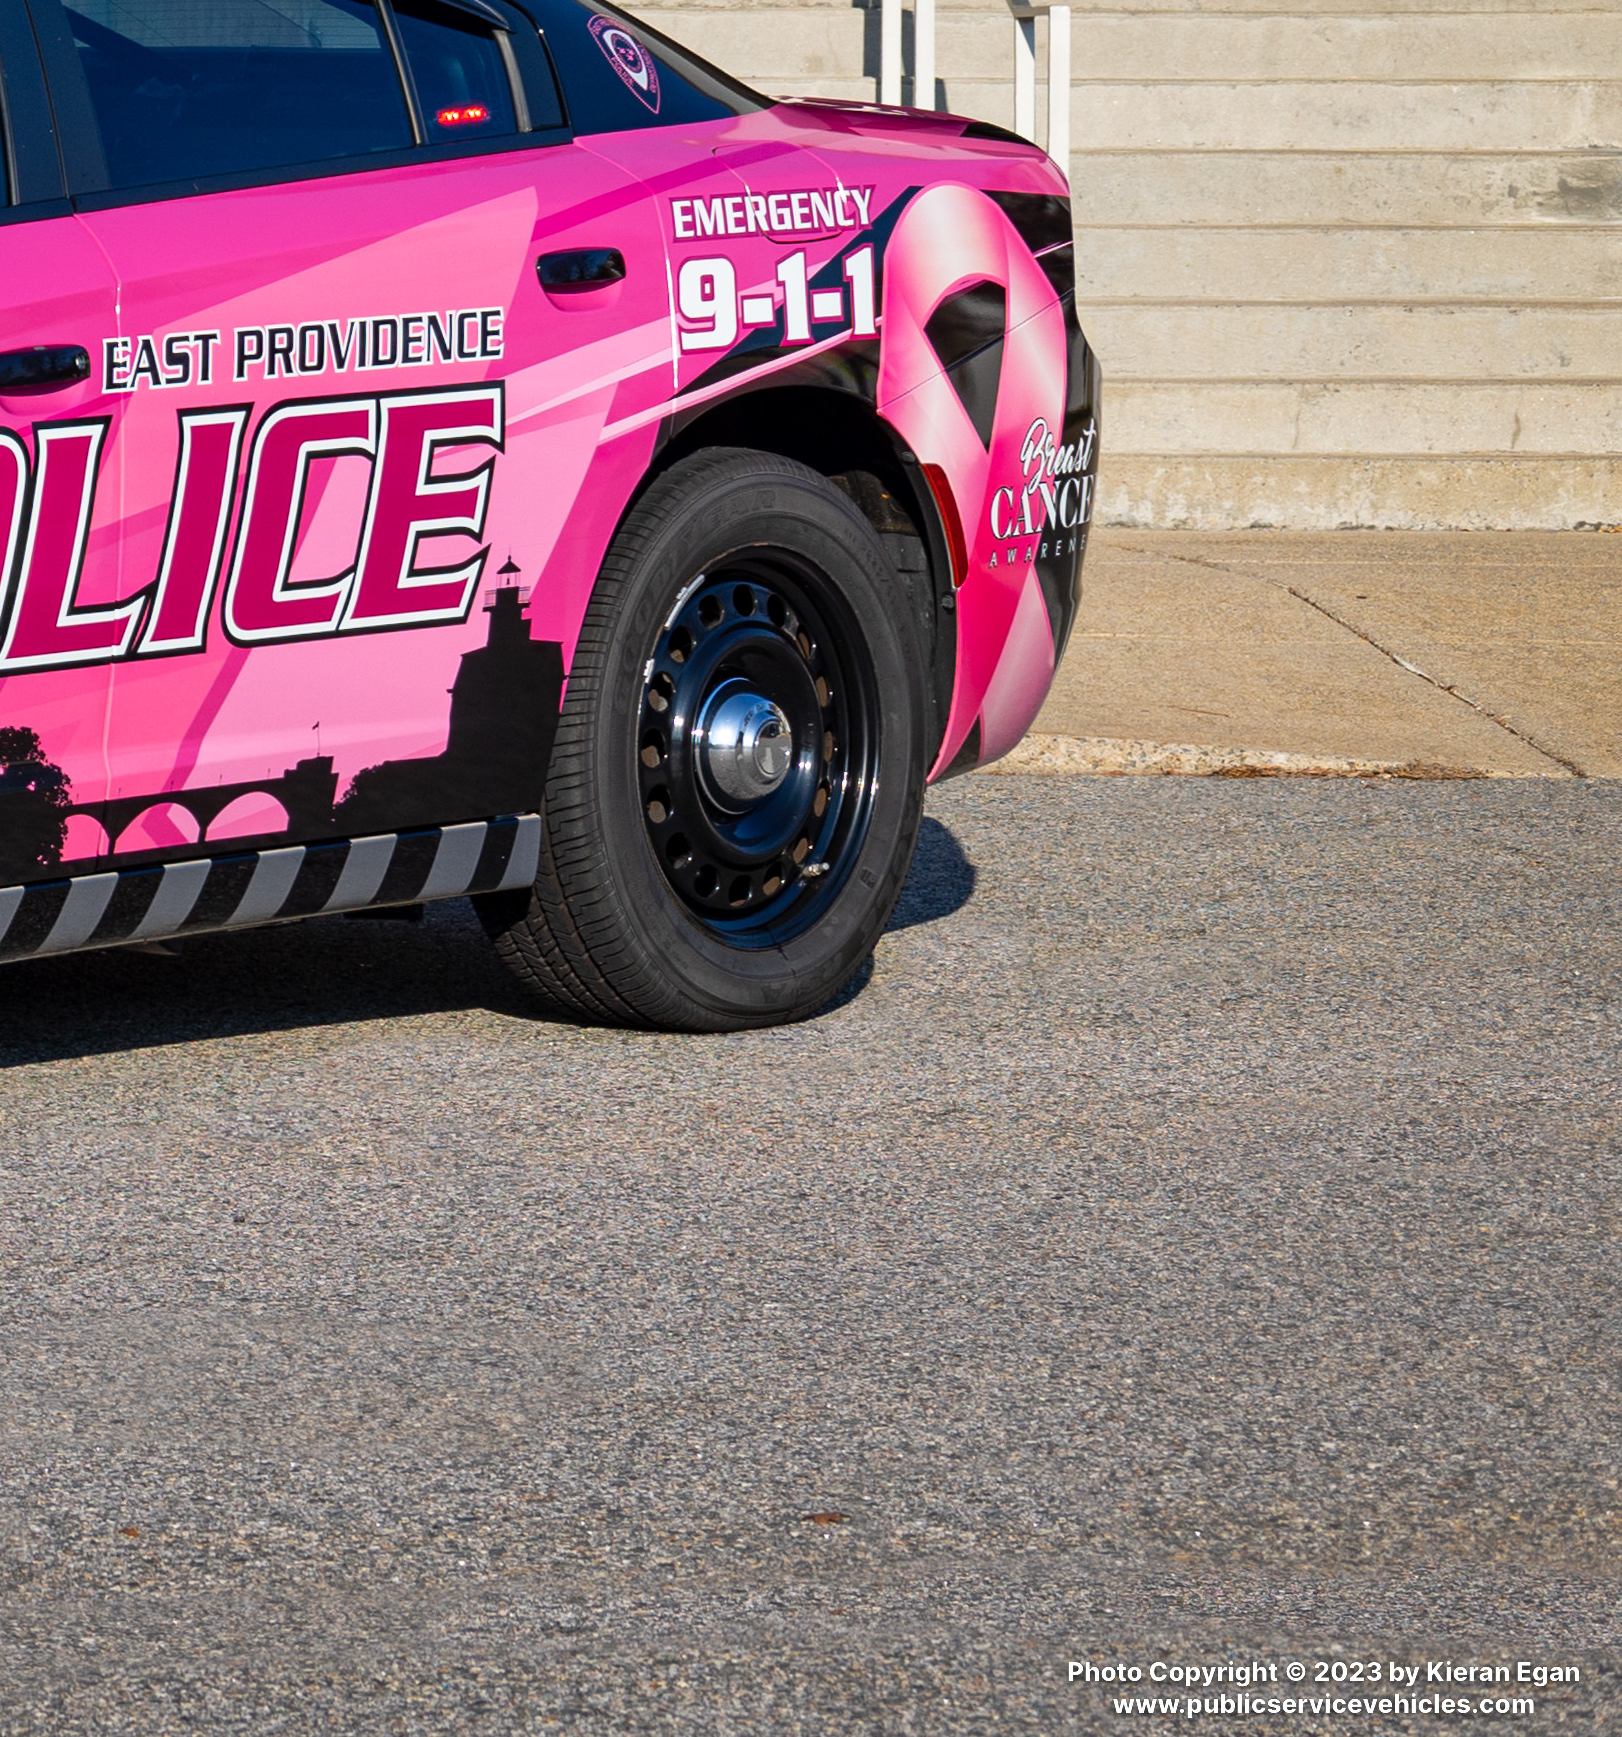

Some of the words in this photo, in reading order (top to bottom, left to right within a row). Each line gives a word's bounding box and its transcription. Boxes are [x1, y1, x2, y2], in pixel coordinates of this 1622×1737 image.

[670, 187, 873, 240] EMERGENCY
[678, 244, 878, 352] 9-1-1
[102, 330, 220, 393] EAST
[233, 306, 504, 381] PROVIDENCE
[1020, 416, 1097, 495] Breast
[990, 474, 1096, 541] CANCE
[988, 533, 1086, 569] AWARENE
